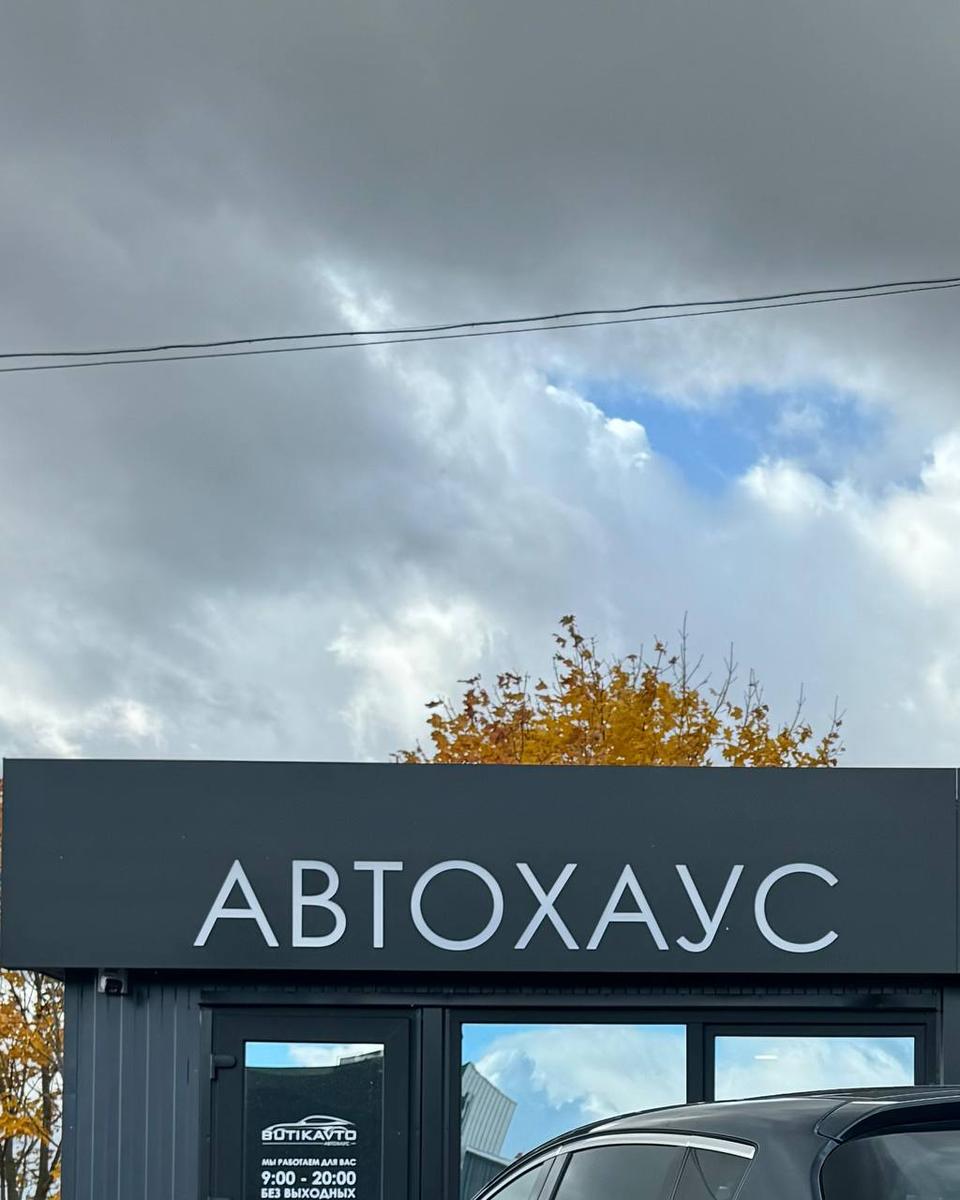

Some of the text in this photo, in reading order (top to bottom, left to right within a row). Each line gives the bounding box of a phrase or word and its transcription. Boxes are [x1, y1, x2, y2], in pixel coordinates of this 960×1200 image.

[194, 859, 839, 954] АВТОХАУС
[262, 1130, 357, 1141] BUTIKAVTO
[262, 1158, 357, 1167] МЫ РАБОТАЕМ ДЛЯ ВАС
[261, 1170, 296, 1186] 9:00
[311, 1170, 357, 1186] 20:00
[261, 1187, 357, 1200] БЕЗ ВЫХОДНЫХ
